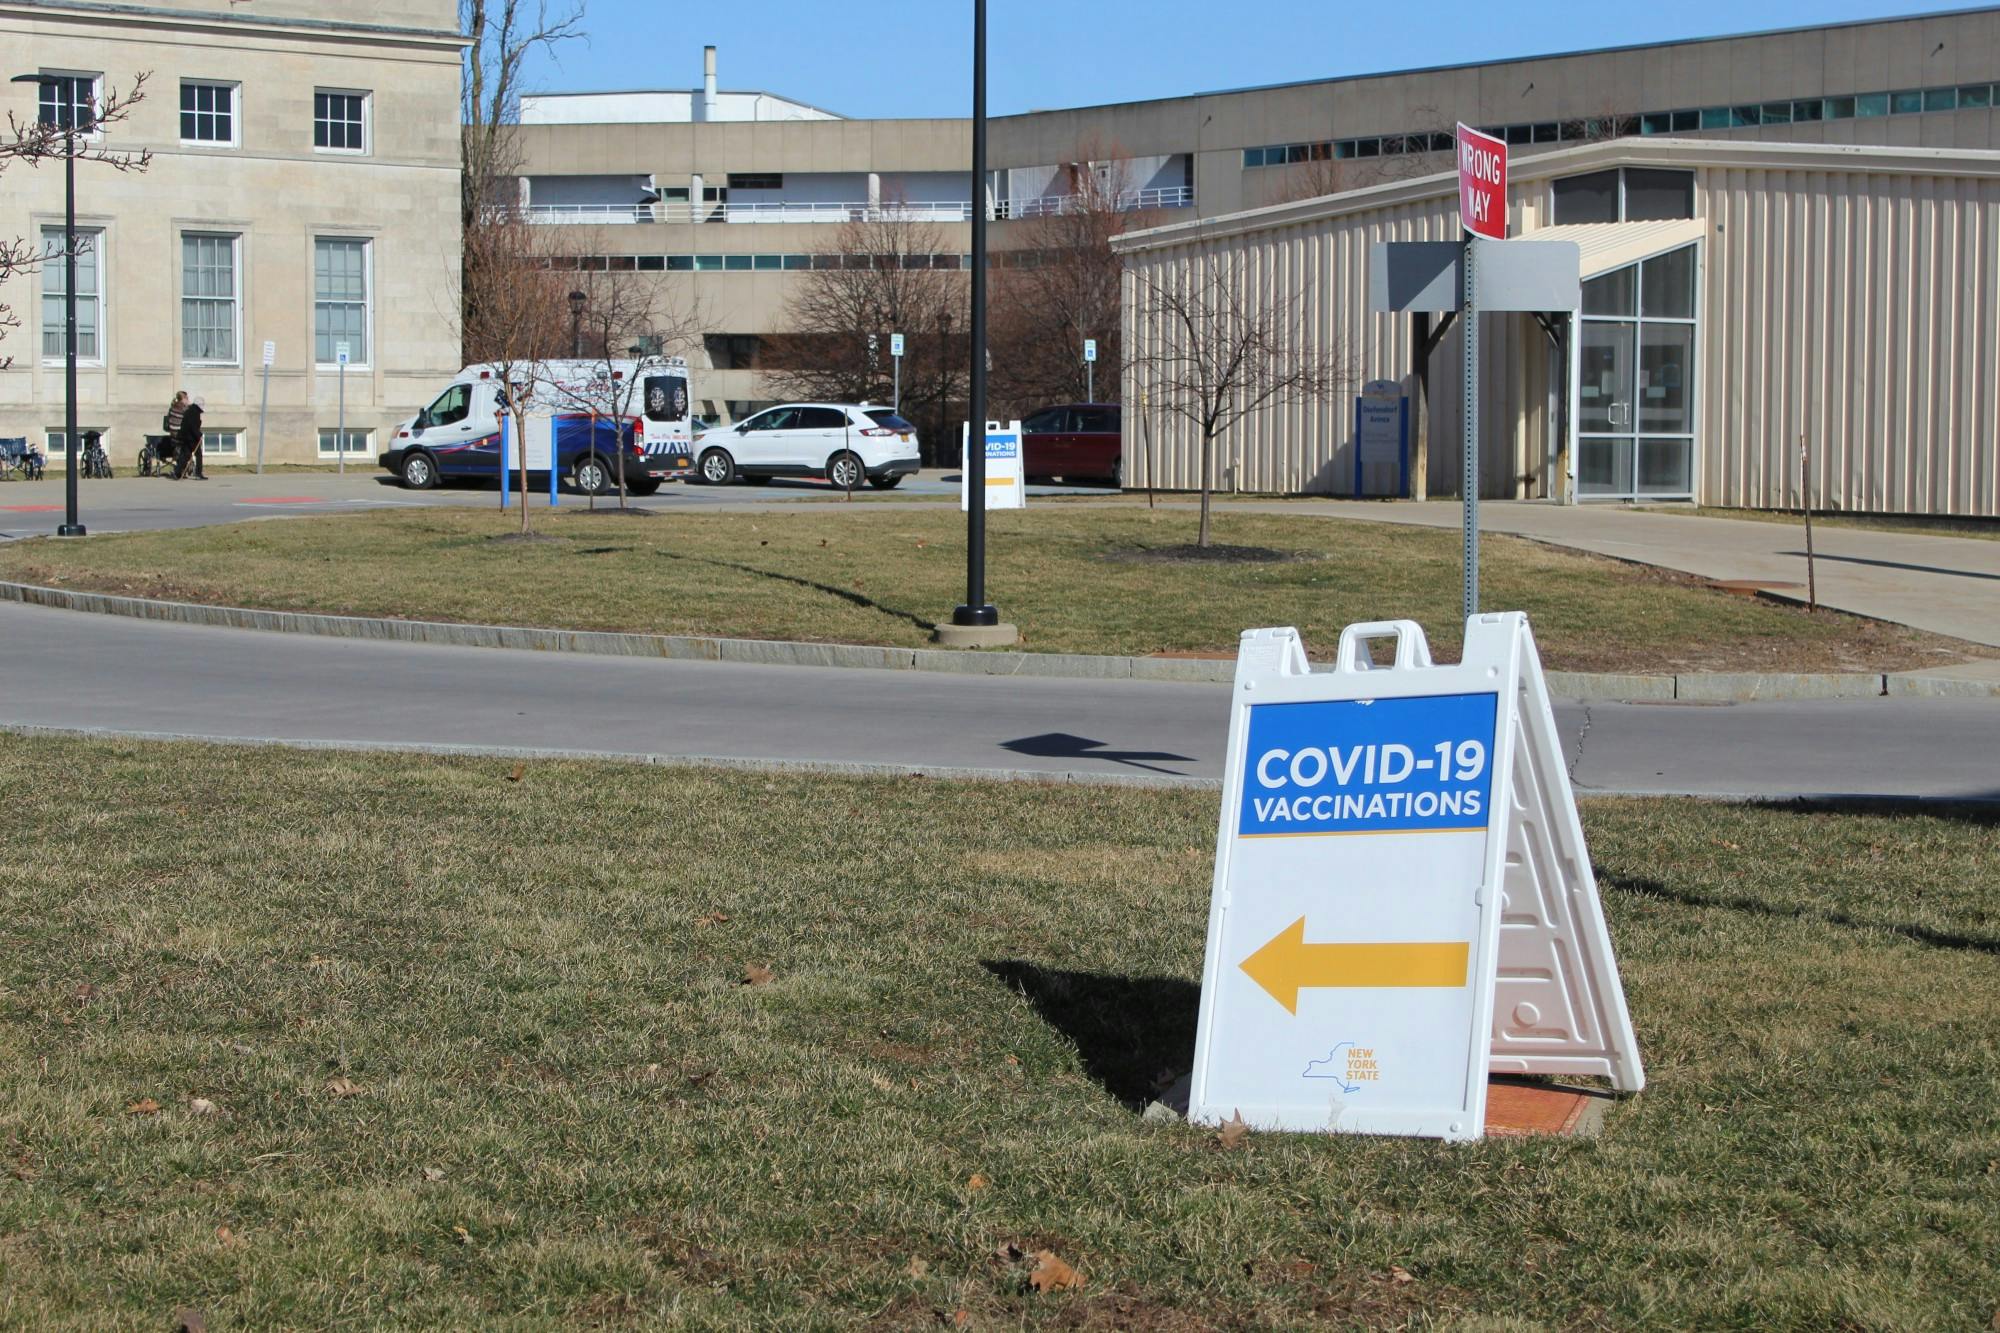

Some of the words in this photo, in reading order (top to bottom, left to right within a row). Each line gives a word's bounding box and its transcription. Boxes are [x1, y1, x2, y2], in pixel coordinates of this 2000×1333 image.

[1461, 140, 1501, 185] WRONG
[1467, 186, 1491, 223] WAY
[985, 442, 1016, 451] VID-19
[1256, 739, 1485, 789] COVID-19
[1253, 790, 1481, 822] VACCINATIONS
[1347, 1048, 1374, 1058] NEW
[1347, 1059, 1377, 1069] YORK
[1346, 1070, 1380, 1080] STATE
